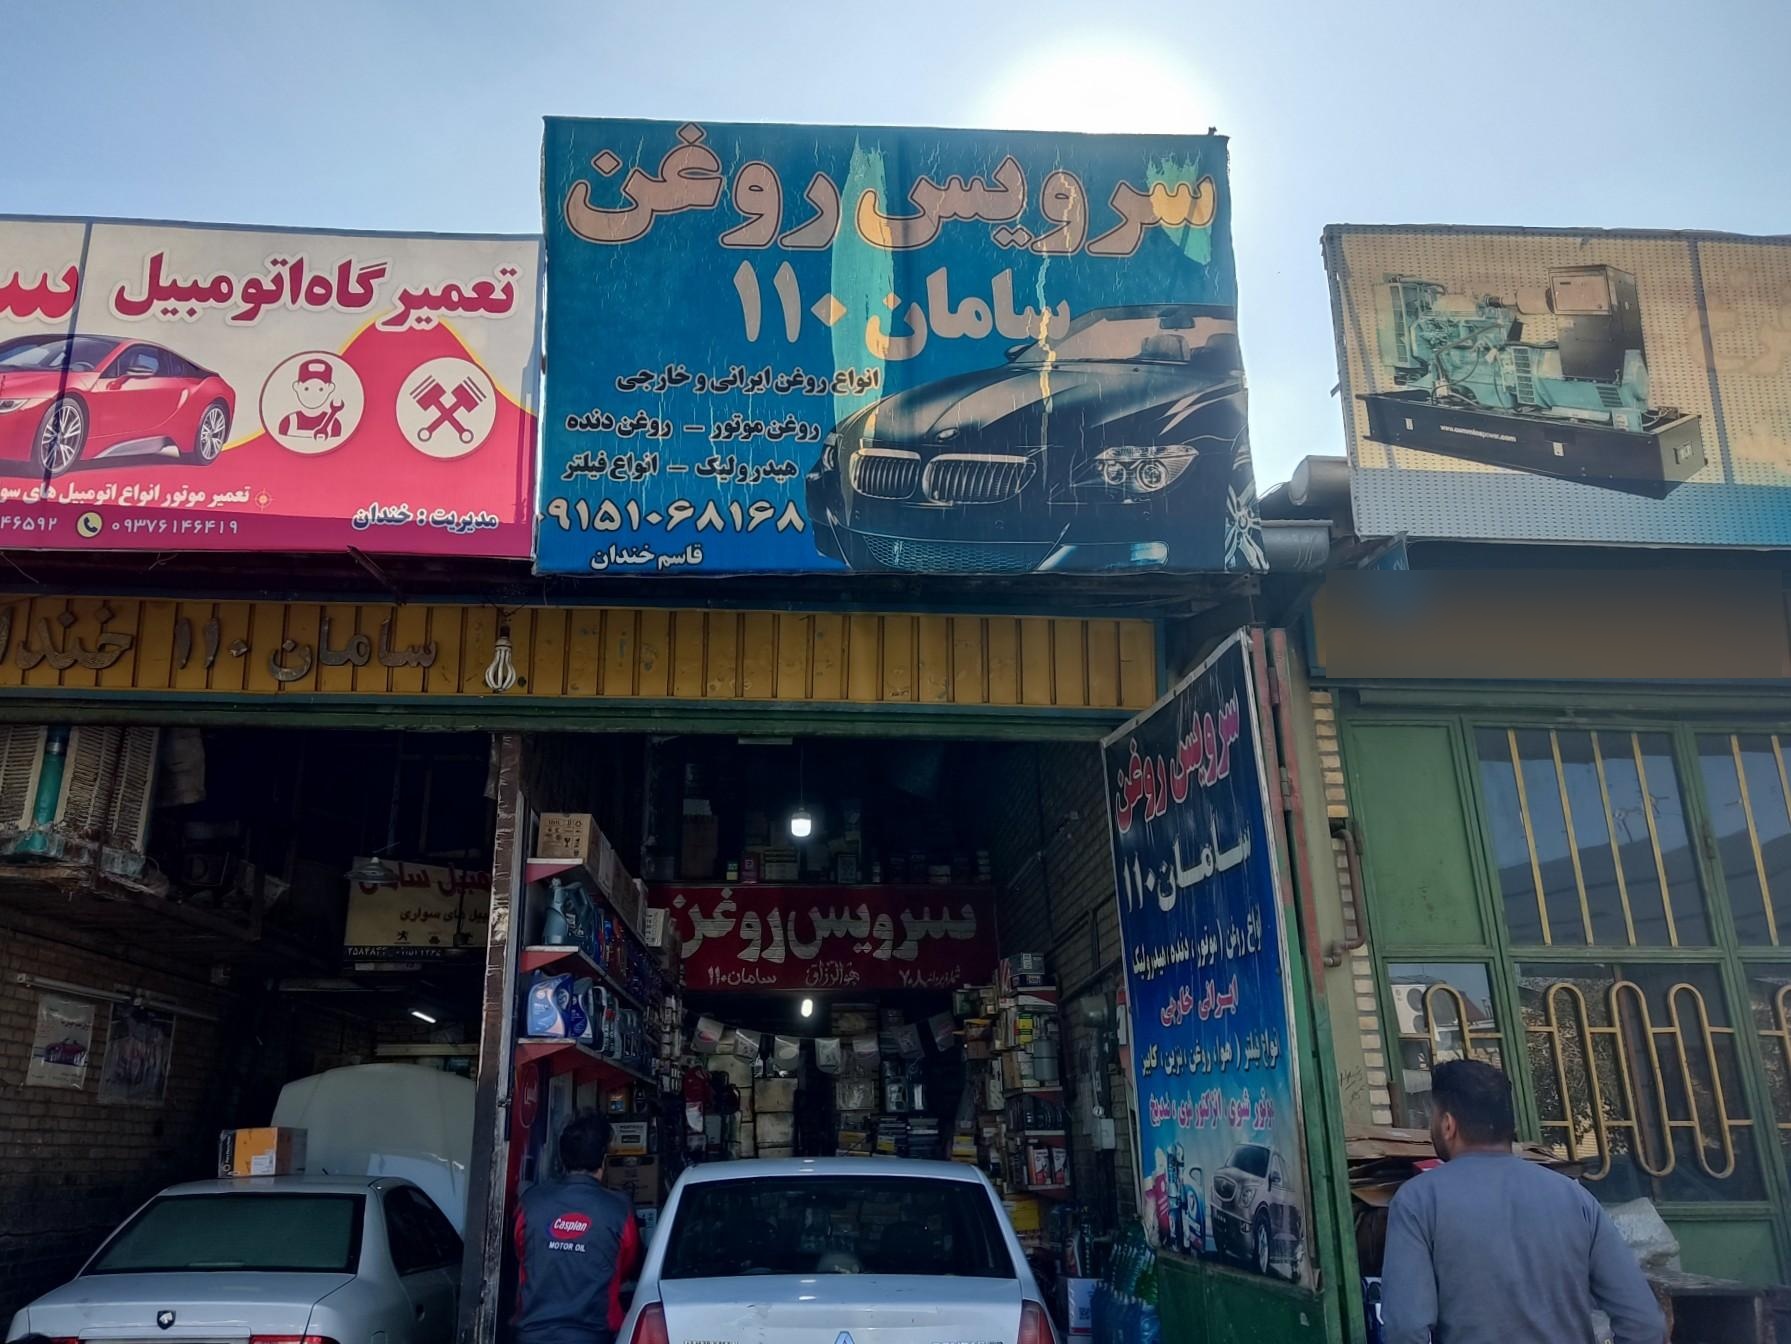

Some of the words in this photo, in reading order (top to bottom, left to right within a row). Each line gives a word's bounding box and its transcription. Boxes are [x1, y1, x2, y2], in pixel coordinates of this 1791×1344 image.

[565, 122, 842, 249] روغن
[856, 154, 1217, 256] سرویس
[733, 260, 847, 343] ۱۱۰
[864, 266, 1071, 359] سامان
[616, 364, 692, 393] خارجی
[695, 372, 708, 393] و
[709, 366, 772, 395] ایرانی
[774, 371, 828, 396] روغن
[830, 367, 881, 395] انواع
[566, 408, 616, 431] دنده
[616, 411, 673, 438] روغن
[711, 412, 765, 441] موتور
[765, 414, 822, 442] روغن
[562, 450, 609, 481] فیلتر
[609, 454, 660, 482] انواع
[695, 454, 799, 484] هیدرولیک
[58, 482, 117, 506] اتومبیل
[118, 483, 160, 507] انواع
[165, 485, 206, 508] موتور
[207, 486, 251, 508] تعمیر
[352, 503, 412, 530] خندان
[590, 544, 656, 570] خندان
[656, 544, 705, 570] قاسم
[267, 614, 437, 682] سامان
[1169, 687, 1241, 805] سرویس
[1115, 736, 1168, 835] روغن
[1157, 812, 1252, 913] سامان
[789, 903, 977, 962] سرویس
[1160, 985, 1194, 1027] خارجی
[1198, 973, 1239, 1021] ایرانی
[553, 1217, 588, 1233] Caspian
[548, 1240, 574, 1251] MOTOR
[574, 1242, 586, 1252] OIL
